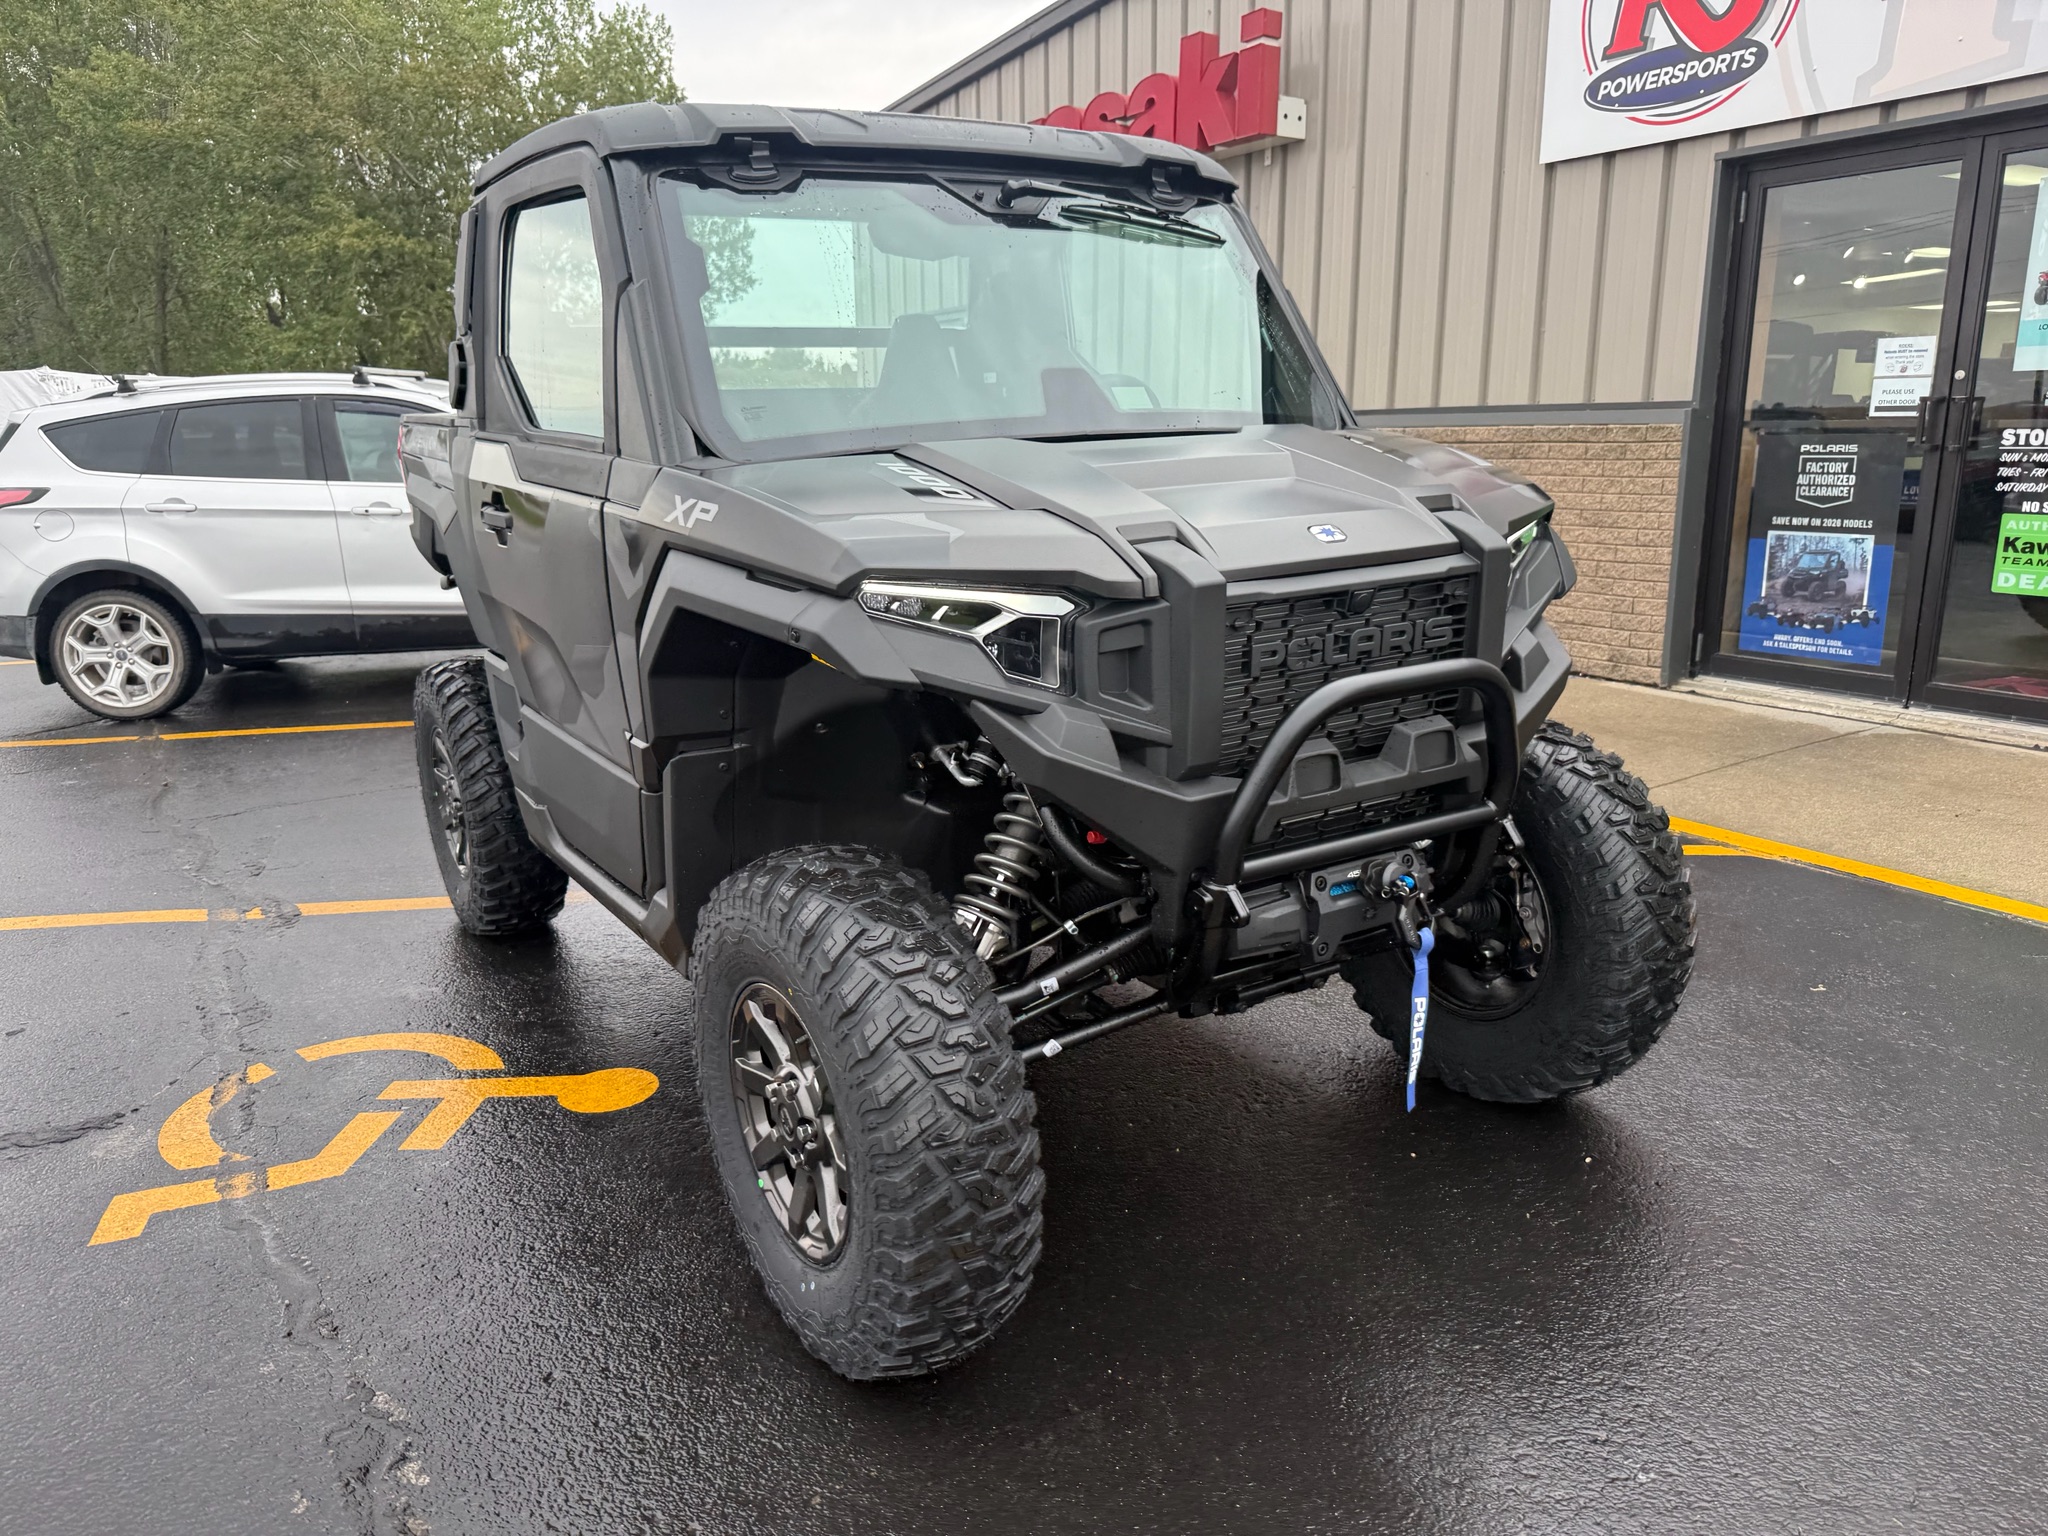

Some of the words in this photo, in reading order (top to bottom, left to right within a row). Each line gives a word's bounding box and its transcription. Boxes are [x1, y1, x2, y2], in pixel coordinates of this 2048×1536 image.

[1597, 47, 1758, 100] POWERSPORTS
[2001, 428, 2048, 446] STO
[1800, 444, 1859, 453] POLARIS
[1999, 452, 2023, 463] SUN
[1805, 461, 1849, 473] FACTORY
[1996, 467, 2022, 477] TUES
[2030, 468, 2048, 478] FRI
[876, 462, 974, 499] 1000
[1796, 474, 1856, 486] AUTHORIZED
[1800, 486, 1850, 497] CLEARANCE
[1995, 481, 2048, 493] SATURDAY
[663, 494, 719, 528] XP
[2021, 501, 2040, 513] NO
[1771, 516, 1790, 525] SAVE
[1791, 517, 1810, 526] NOW
[1810, 518, 1821, 526] ON
[1843, 519, 1873, 529] MODELS
[2001, 556, 2048, 567] TEAM
[1792, 635, 1814, 644] OFFERS
[1814, 637, 1825, 645] END
[1251, 616, 1453, 678] POLARIS
[1779, 641, 1817, 652] SALESPERSON
[1817, 645, 1828, 653] FOR
[1408, 997, 1426, 1085] POLARIS
